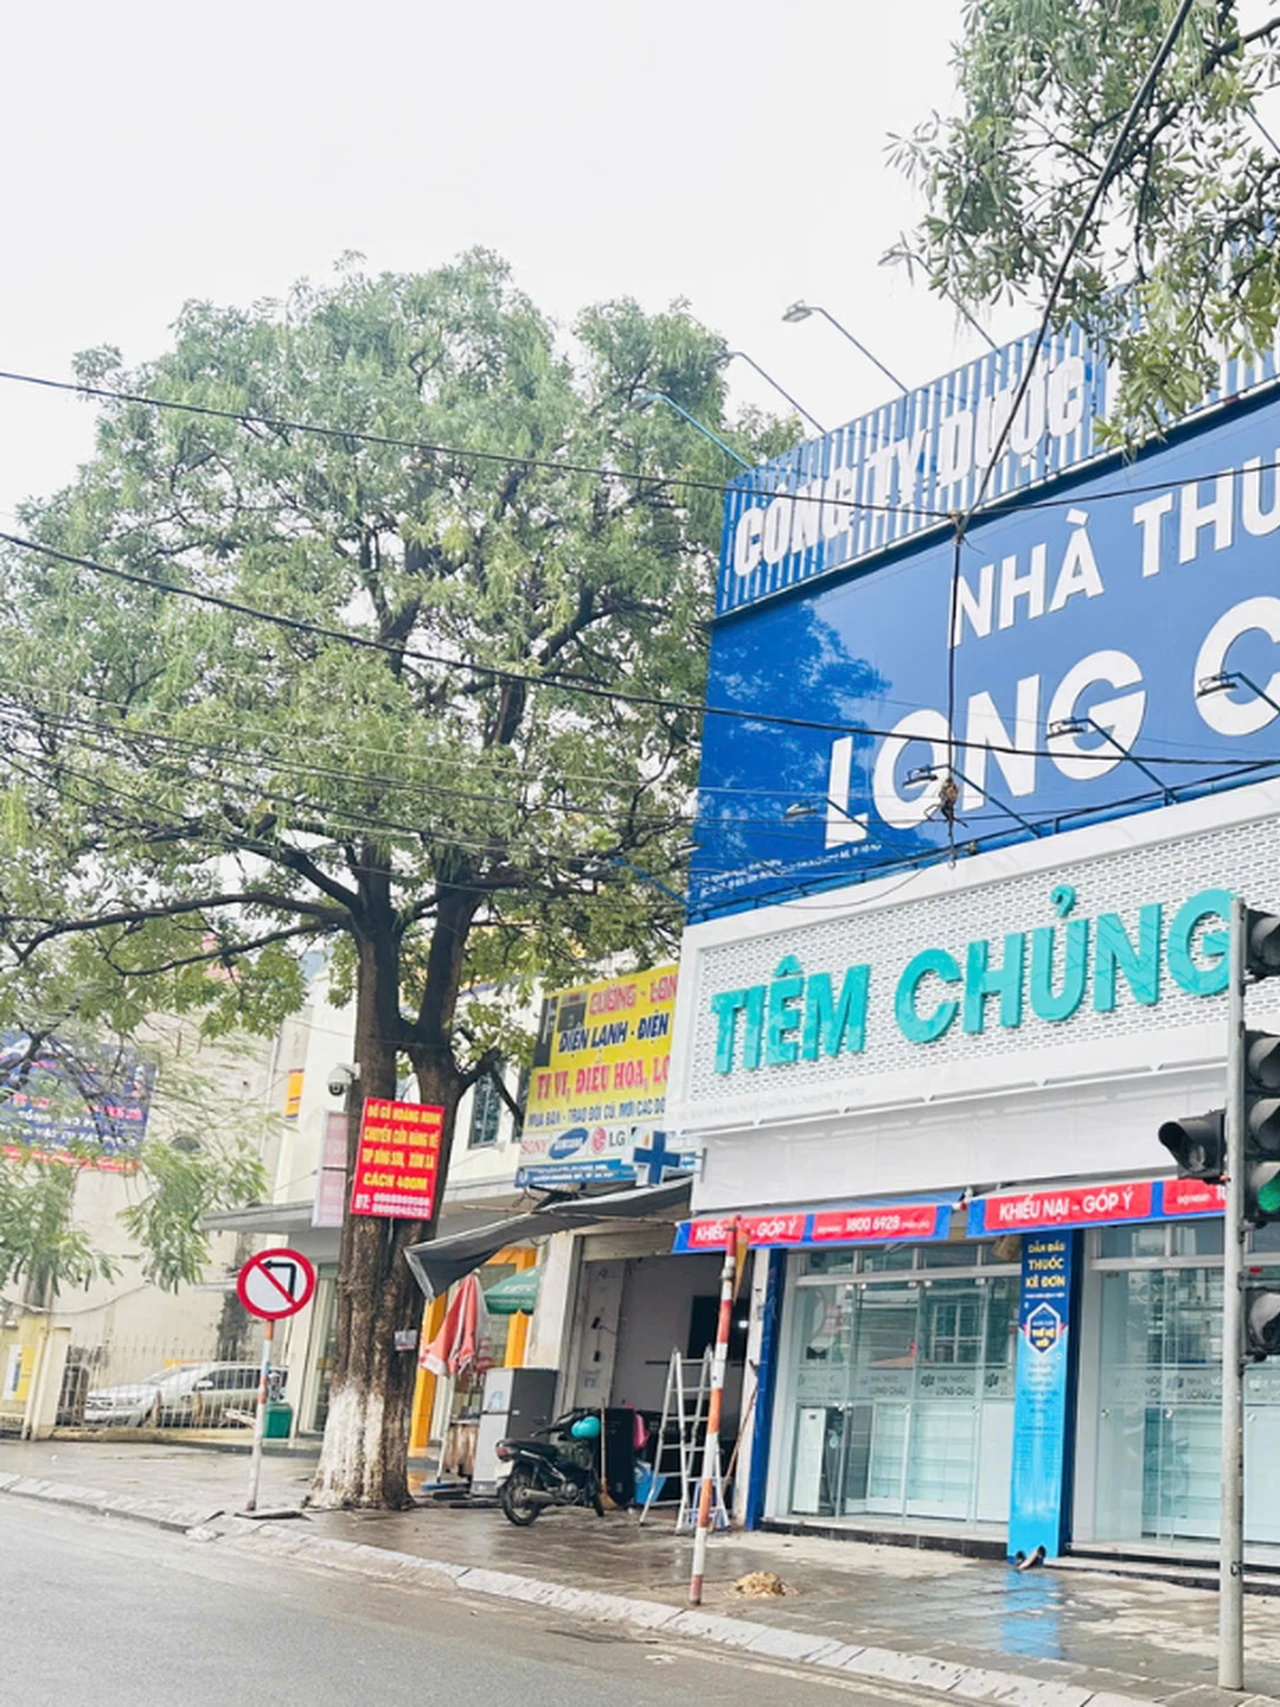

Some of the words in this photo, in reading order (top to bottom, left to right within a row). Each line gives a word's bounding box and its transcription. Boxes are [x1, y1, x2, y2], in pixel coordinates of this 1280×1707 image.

[734, 466, 853, 577] CÔNG
[864, 428, 927, 518] TY
[938, 356, 1085, 488] DƯỢC
[950, 509, 1104, 648] NHÀ
[825, 650, 1147, 849] LONG
[711, 954, 871, 1075] TIÊM
[895, 885, 1238, 1045] CHỦNG
[559, 1021, 589, 1058] ĐIỆN
[591, 1021, 629, 1053] LẠNH
[637, 1009, 670, 1044] ĐIỆN
[609, 1131, 626, 1147] LG
[757, 1216, 784, 1237] GÓP
[787, 1215, 798, 1235] Ý
[846, 1217, 871, 1232] 1800
[873, 1215, 900, 1230] 6928
[999, 1193, 1041, 1222] KHIẾU
[1042, 1197, 1069, 1223] NẠI
[1083, 1192, 1118, 1215] GÓP
[1121, 1186, 1133, 1210] Ý
[1028, 1254, 1065, 1270] THUỐC
